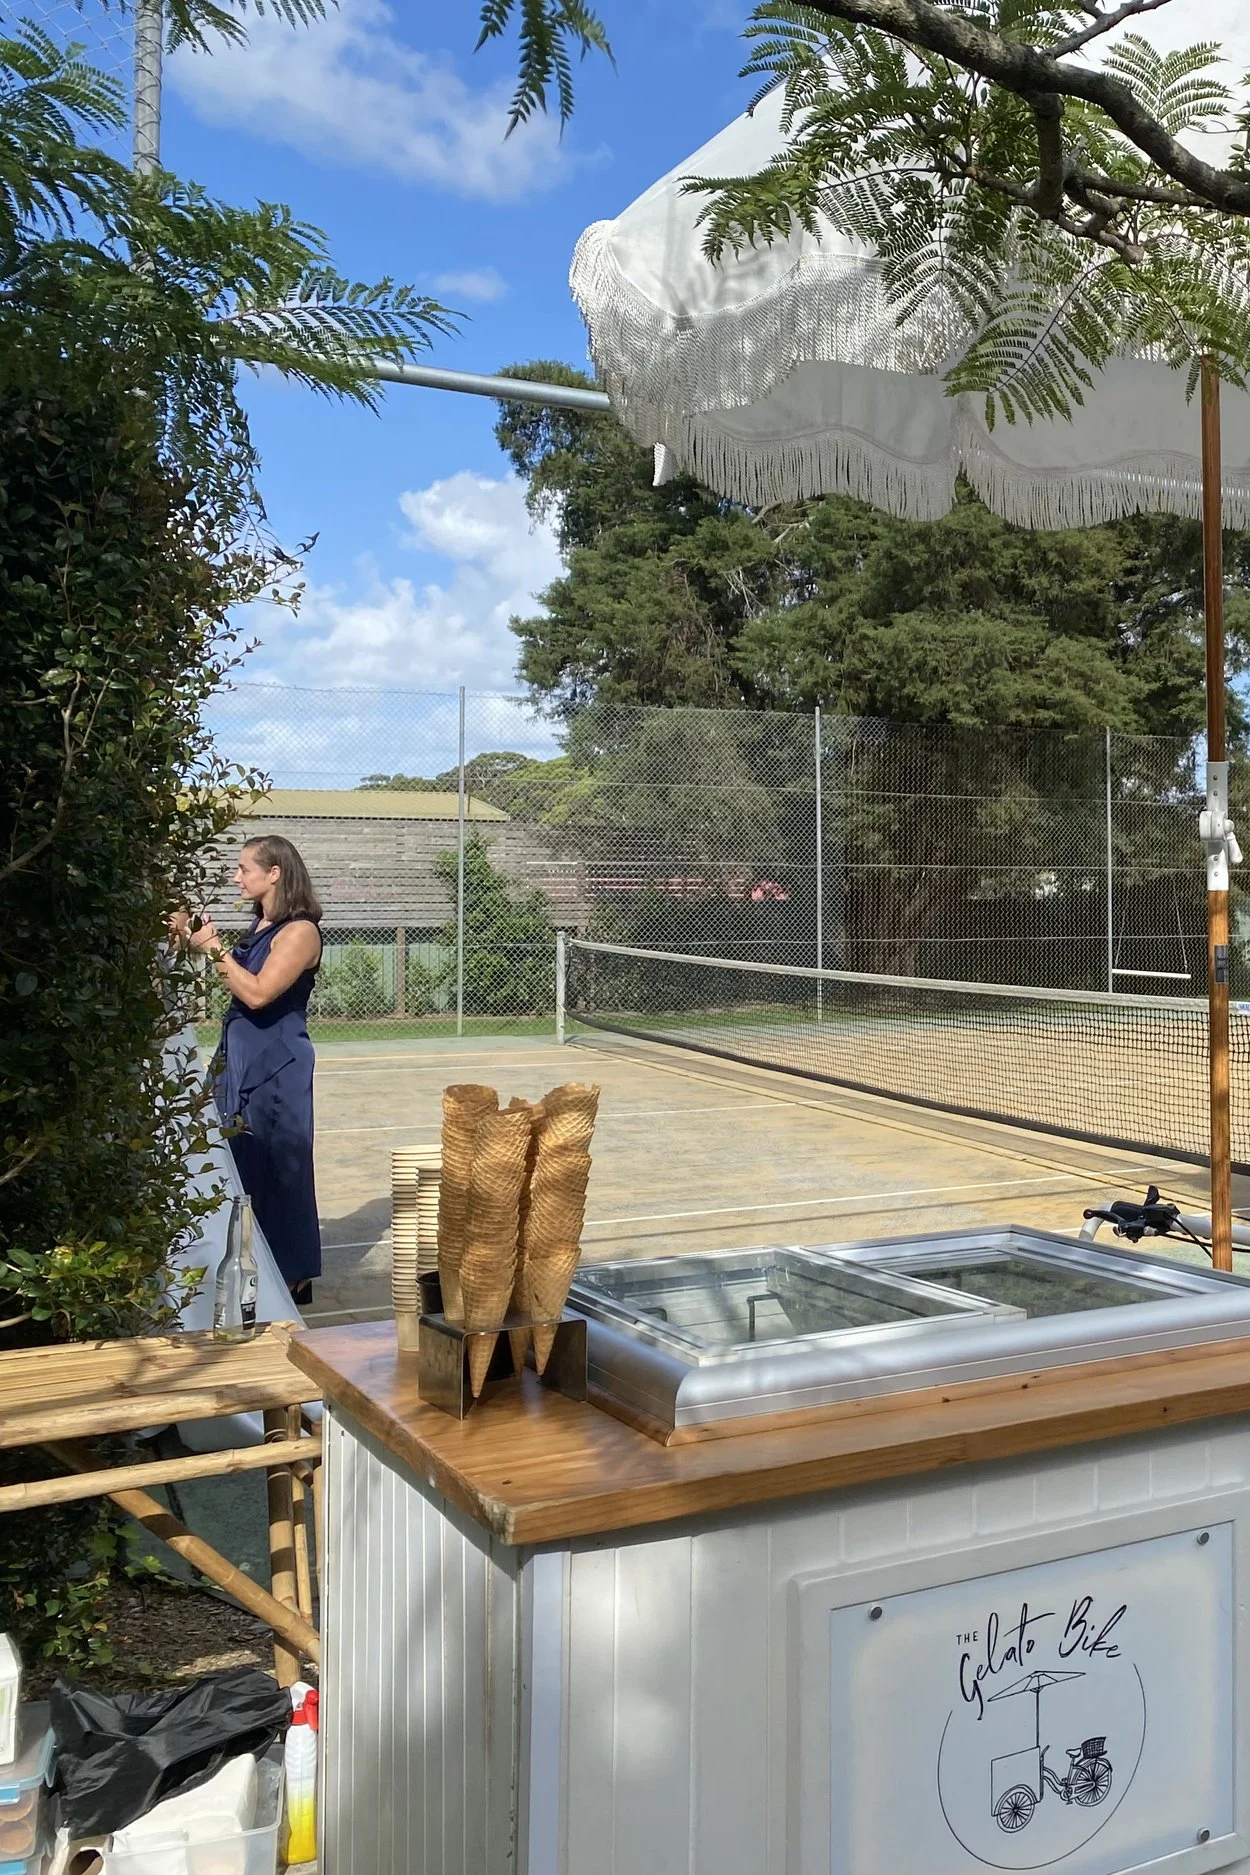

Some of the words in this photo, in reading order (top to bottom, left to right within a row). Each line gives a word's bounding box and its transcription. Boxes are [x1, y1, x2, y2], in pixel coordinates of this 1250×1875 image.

[956, 1630, 979, 1645] THE
[1058, 1595, 1127, 1658] Bike
[959, 1602, 1056, 1721] Gelato
